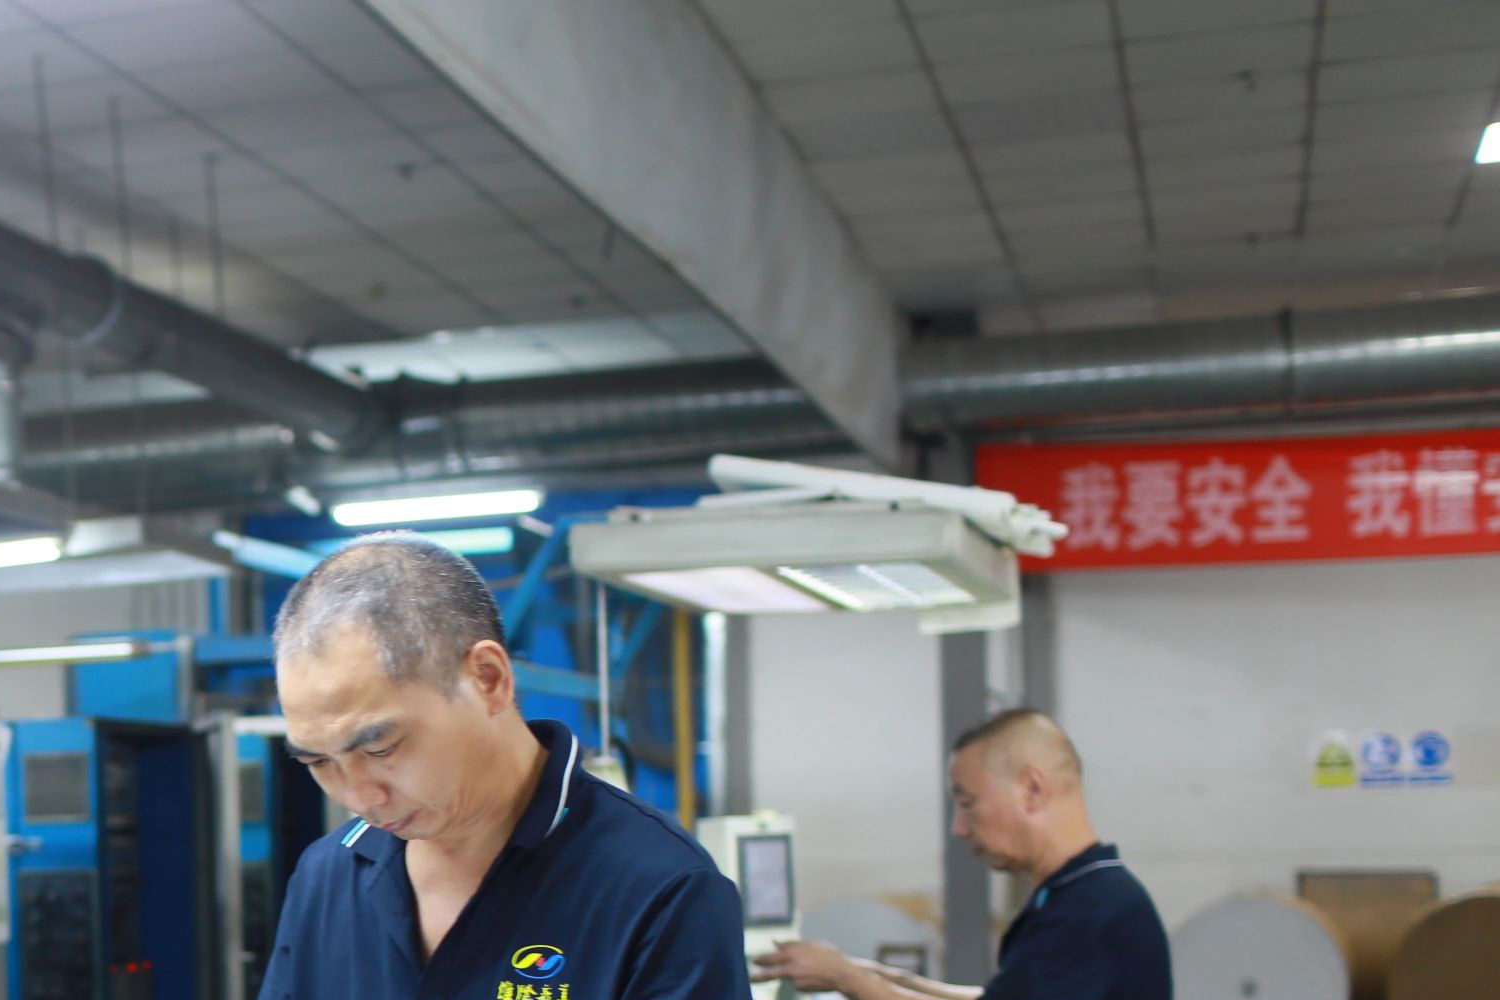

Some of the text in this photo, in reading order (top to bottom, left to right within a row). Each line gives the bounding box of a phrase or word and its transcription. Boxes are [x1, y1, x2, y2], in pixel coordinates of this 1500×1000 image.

[1061, 449, 1500, 550] 我要安全 我懂
